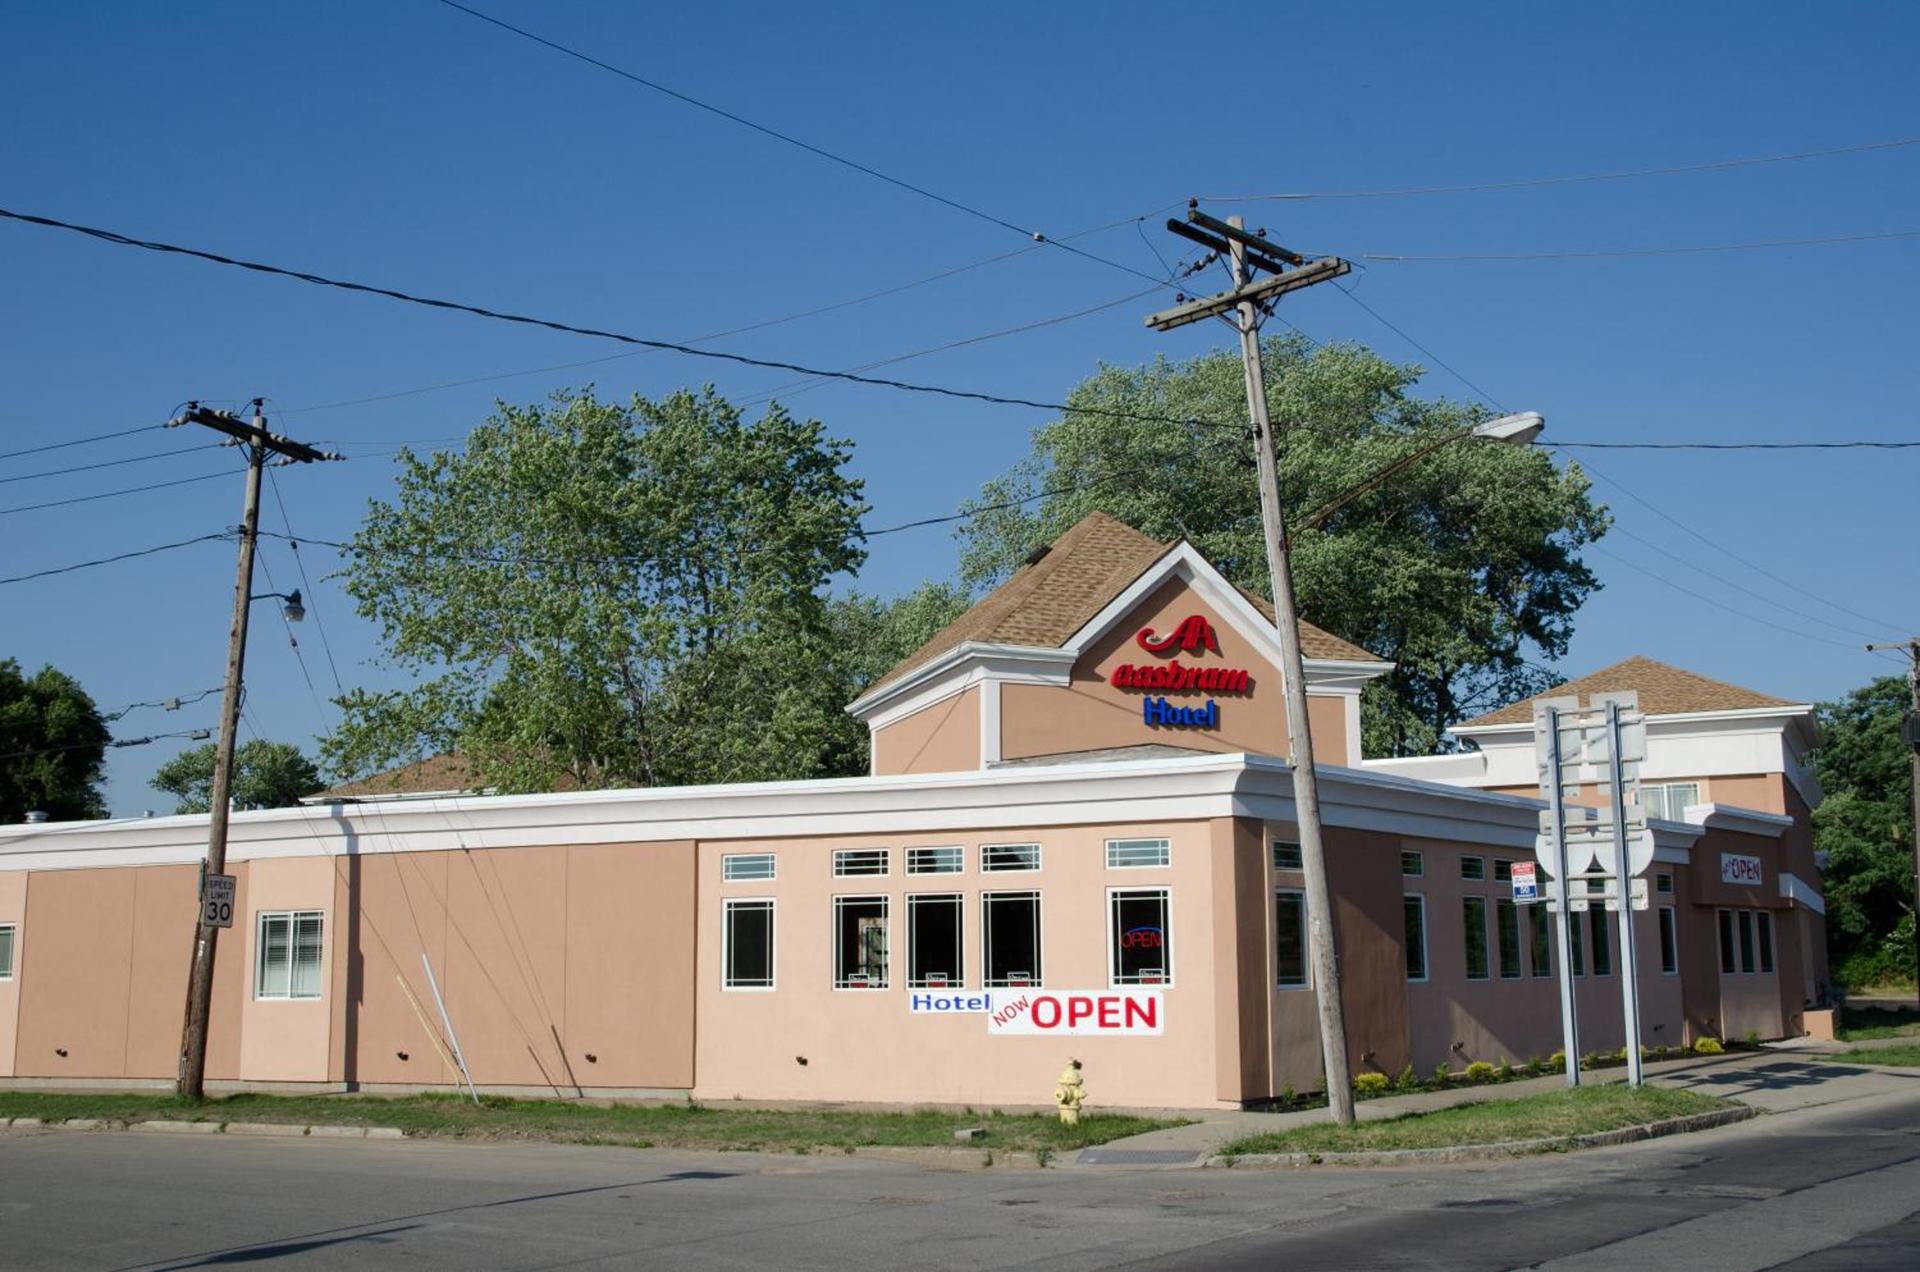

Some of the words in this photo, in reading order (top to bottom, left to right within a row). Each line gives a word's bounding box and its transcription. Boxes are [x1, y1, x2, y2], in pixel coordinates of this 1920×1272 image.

[1143, 696, 1215, 727] Hotel
[1732, 858, 1760, 880] OPEN
[209, 880, 233, 890] SPEED
[211, 891, 230, 900] LIMIT
[207, 902, 230, 921] 30
[1121, 931, 1162, 948] OPEN
[912, 994, 990, 1011] Hotel
[993, 995, 1030, 1027] NOW
[1031, 996, 1157, 1028] OPEN
